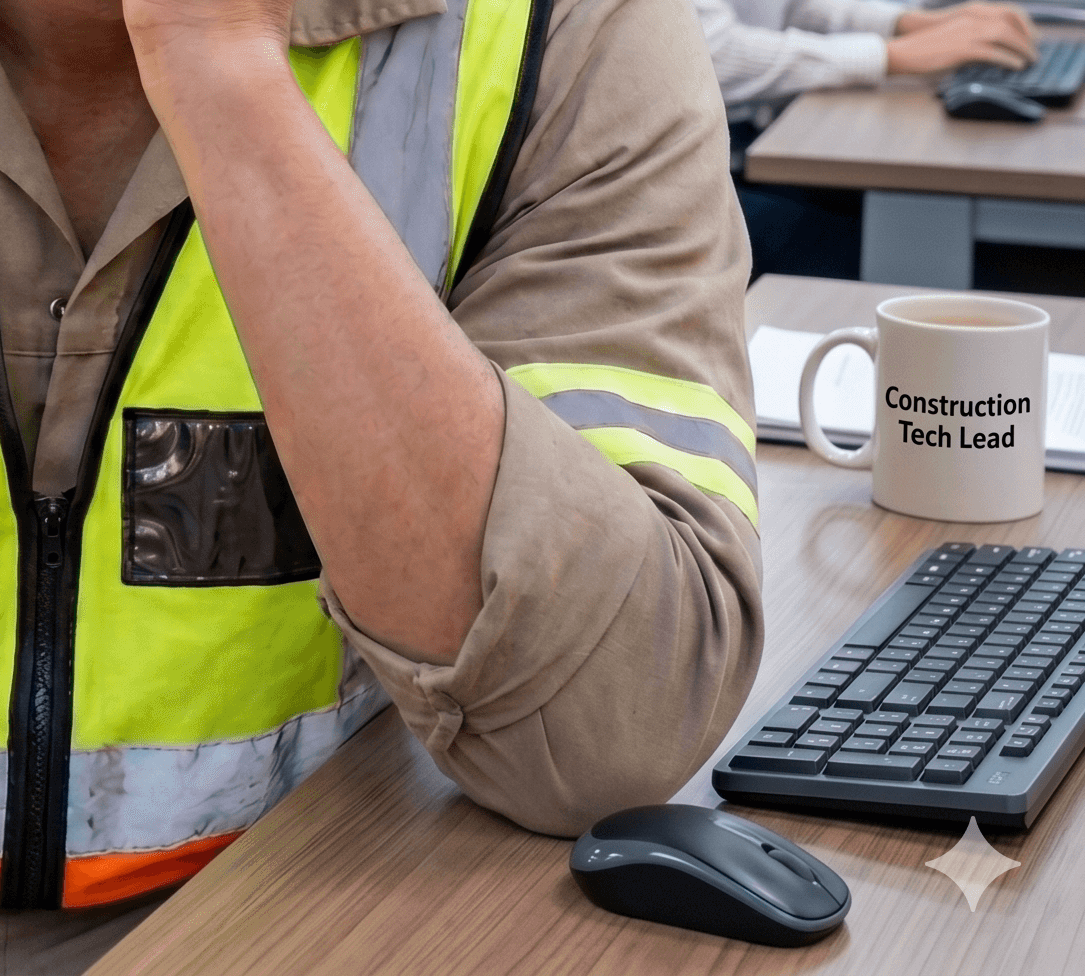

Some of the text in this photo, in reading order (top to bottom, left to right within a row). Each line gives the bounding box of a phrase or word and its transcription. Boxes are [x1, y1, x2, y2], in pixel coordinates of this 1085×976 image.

[885, 385, 1031, 418] Construction
[898, 419, 1015, 450] Tech Lead
